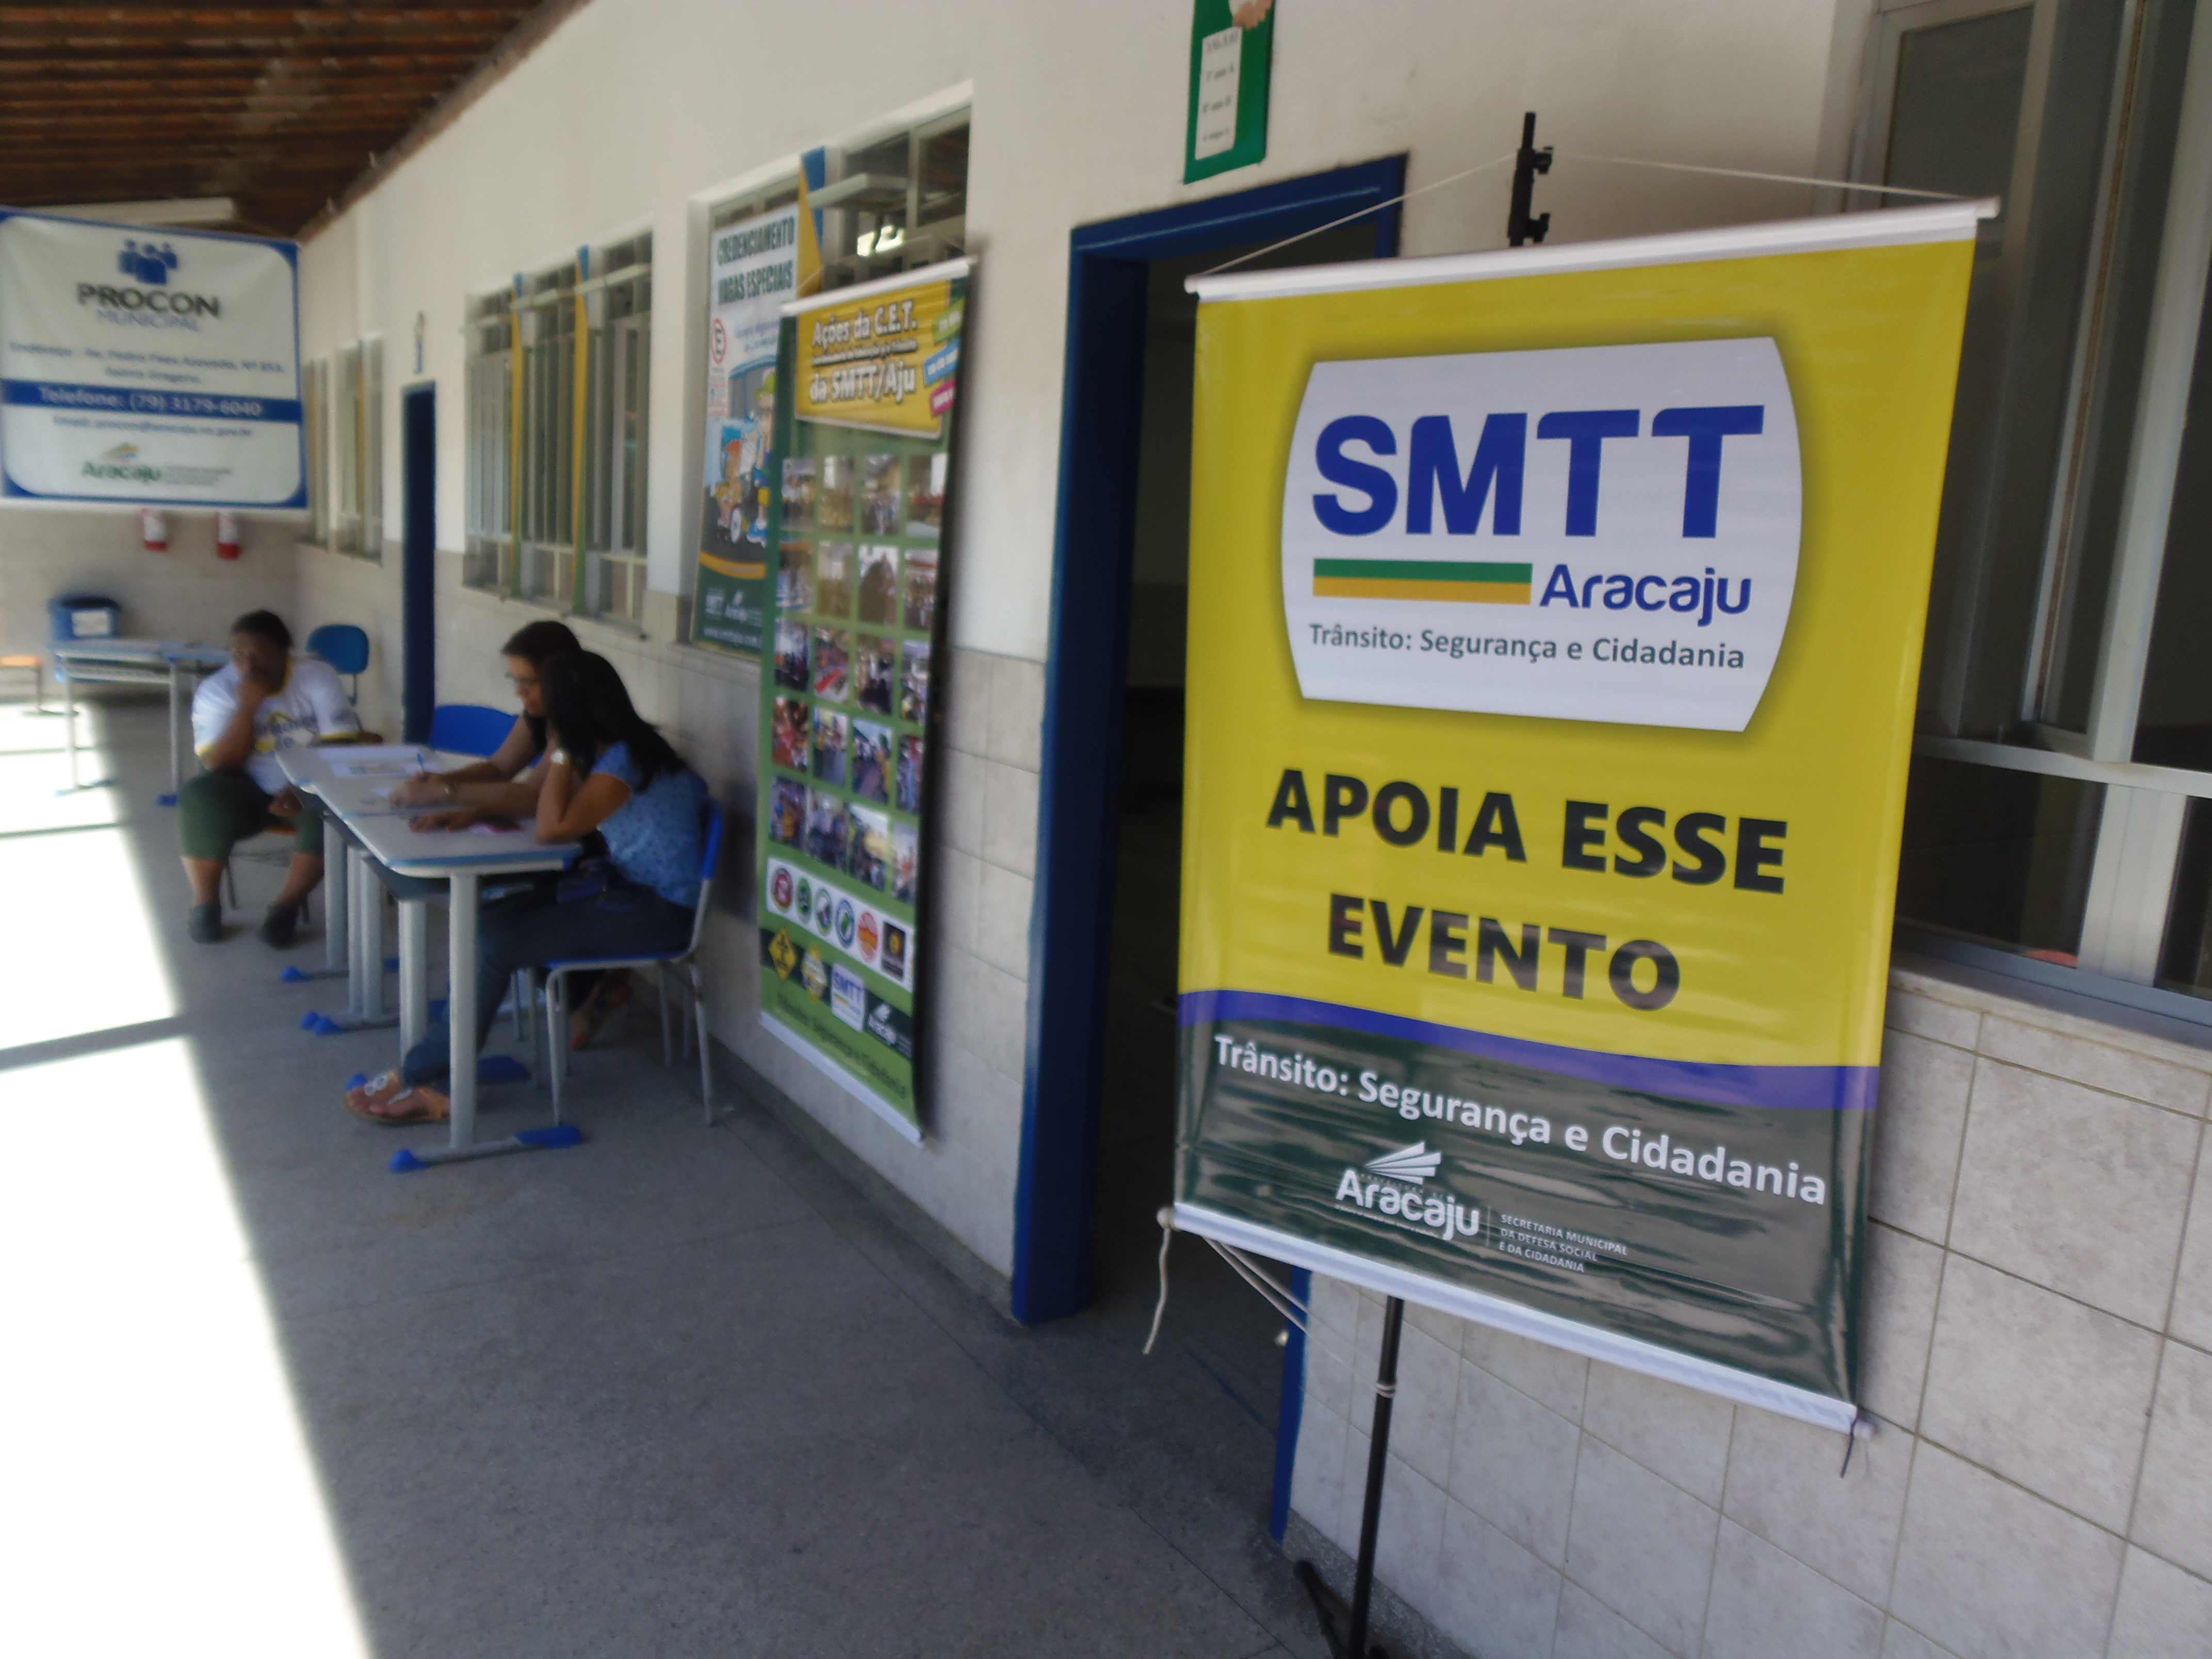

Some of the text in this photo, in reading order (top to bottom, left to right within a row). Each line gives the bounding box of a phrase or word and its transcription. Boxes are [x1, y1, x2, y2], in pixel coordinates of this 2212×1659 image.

[78, 283, 220, 319] PROCON
[874, 299, 917, 336] C.E.T.
[810, 372, 827, 403] da
[832, 359, 917, 404] SMTT/Aju
[82, 462, 162, 484] Aracaju
[1312, 405, 1764, 538] SMTT
[1539, 564, 1751, 627] Aracaju
[1309, 623, 1745, 669] Trânsito: Segurança e Cidadania
[1266, 769, 1787, 894] APOIA ESSE
[1328, 892, 1680, 1012] EVENTO
[1214, 1034, 1827, 1205] Trânsito: Segurança e Cidadania
[1335, 1169, 1479, 1240] Aracaju
[1499, 1242, 1585, 1273] E DA CIDADANIA
[1500, 1228, 1598, 1262] DA DEFESA SOCIAL
[1501, 1214, 1628, 1256] SECRETARIA MUNICIPAL
